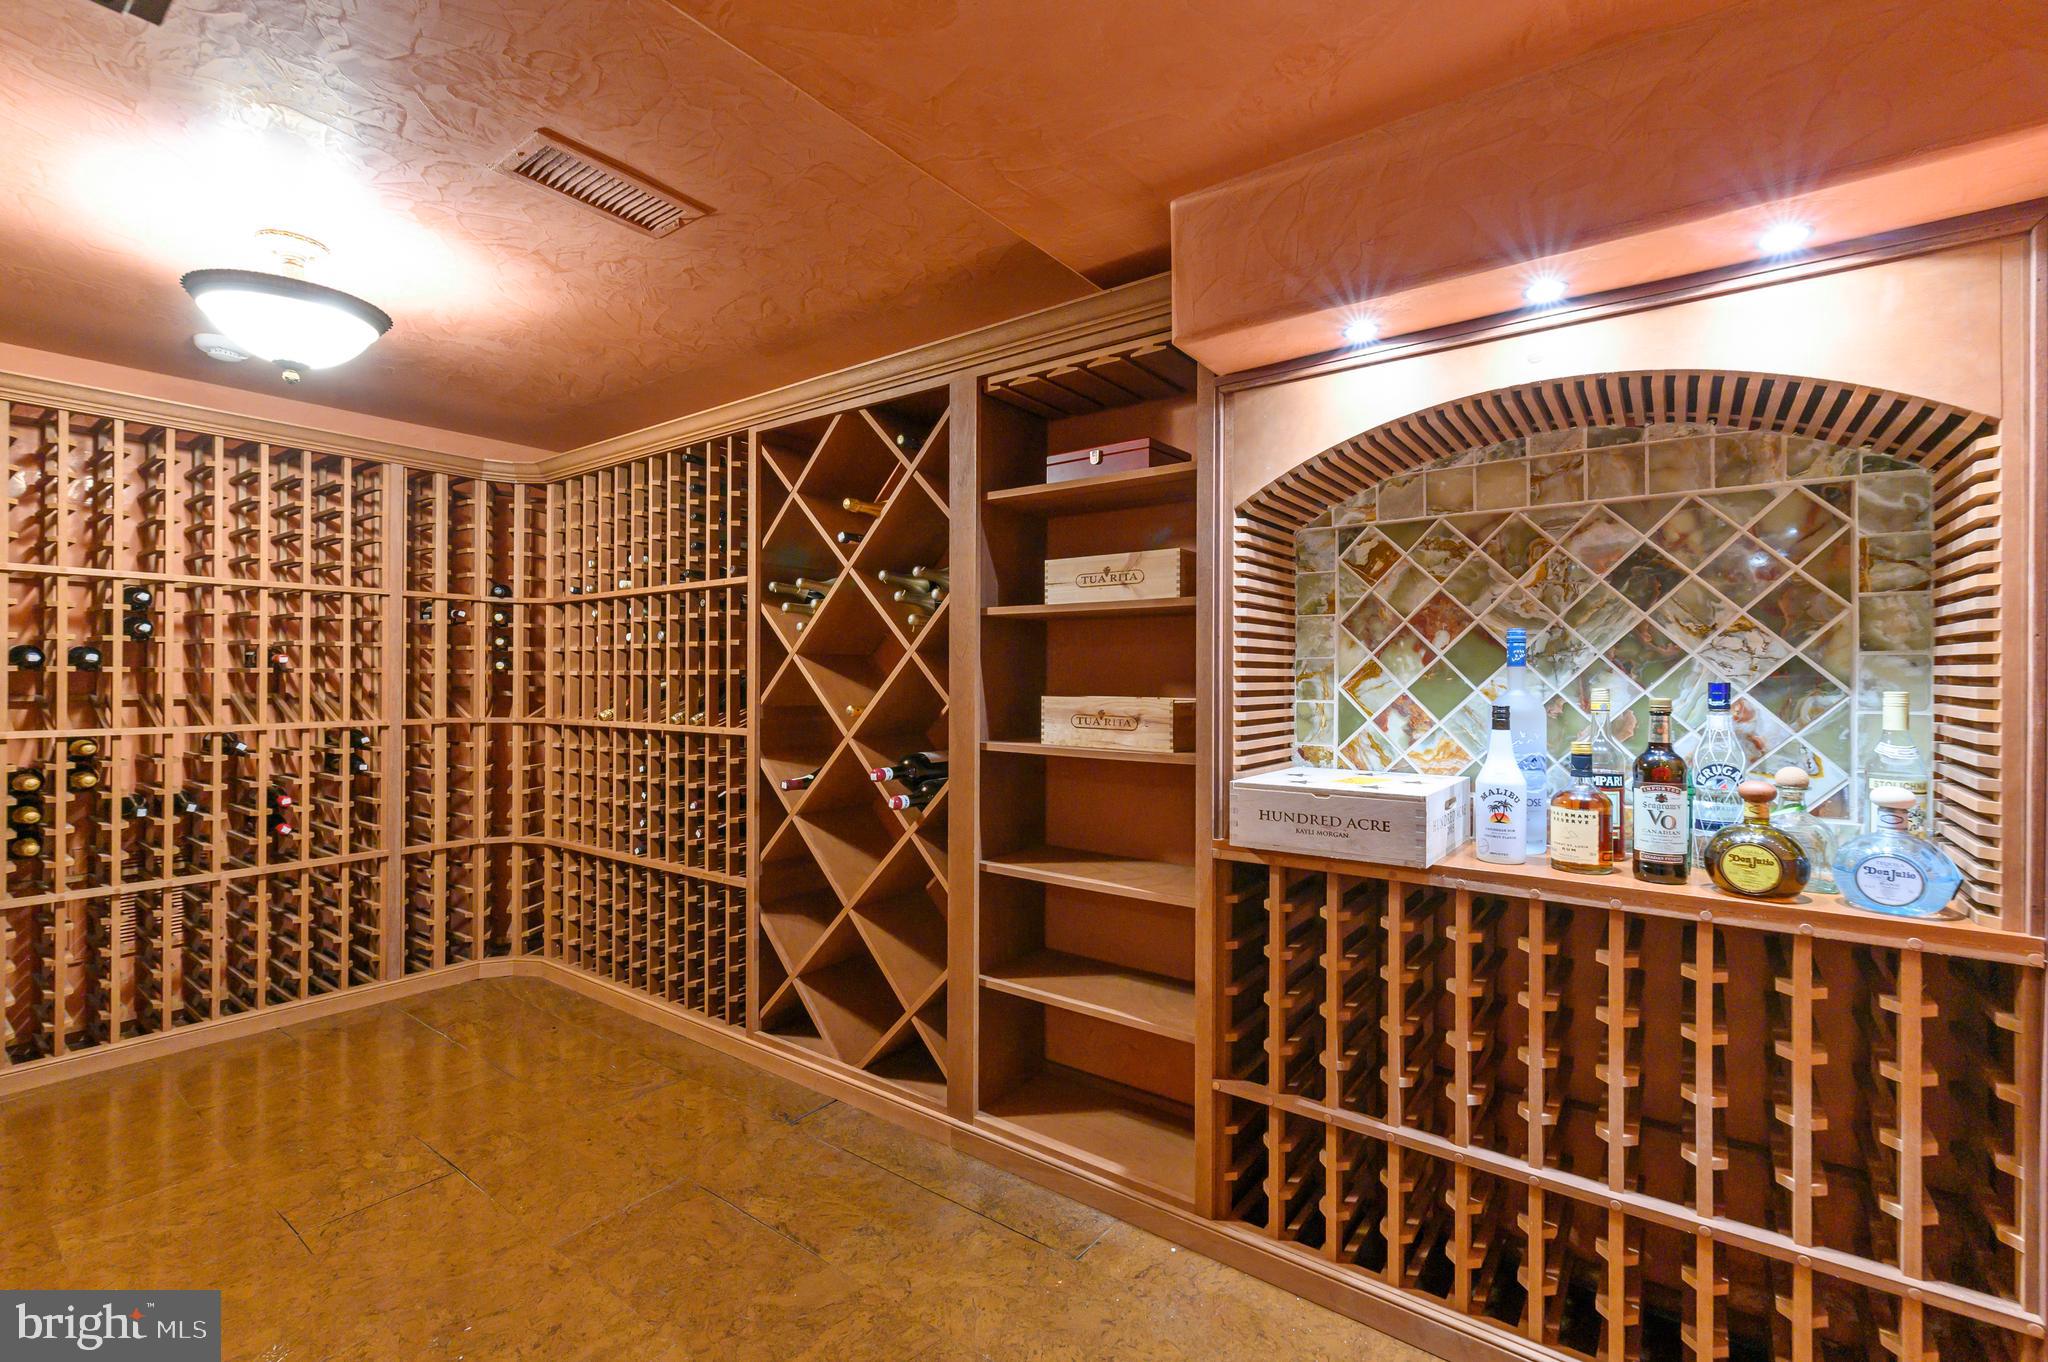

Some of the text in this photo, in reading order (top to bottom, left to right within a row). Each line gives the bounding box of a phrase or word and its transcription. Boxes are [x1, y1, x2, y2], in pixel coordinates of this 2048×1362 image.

[1080, 572, 1138, 585] TUA RITA
[1076, 716, 1132, 728] TUA RITA
[1480, 788, 1520, 803] MALIBU
[1527, 798, 1542, 807] OSE
[1258, 809, 1391, 833] HUNDRED ACRE
[1553, 811, 1597, 819] AIRMAN'S
[1295, 828, 1349, 839] KAYLI MORGAN
[1641, 828, 1681, 836] ANADIAN
[1728, 853, 1775, 869] Don Julio
[1863, 866, 1917, 882] Don Julio
